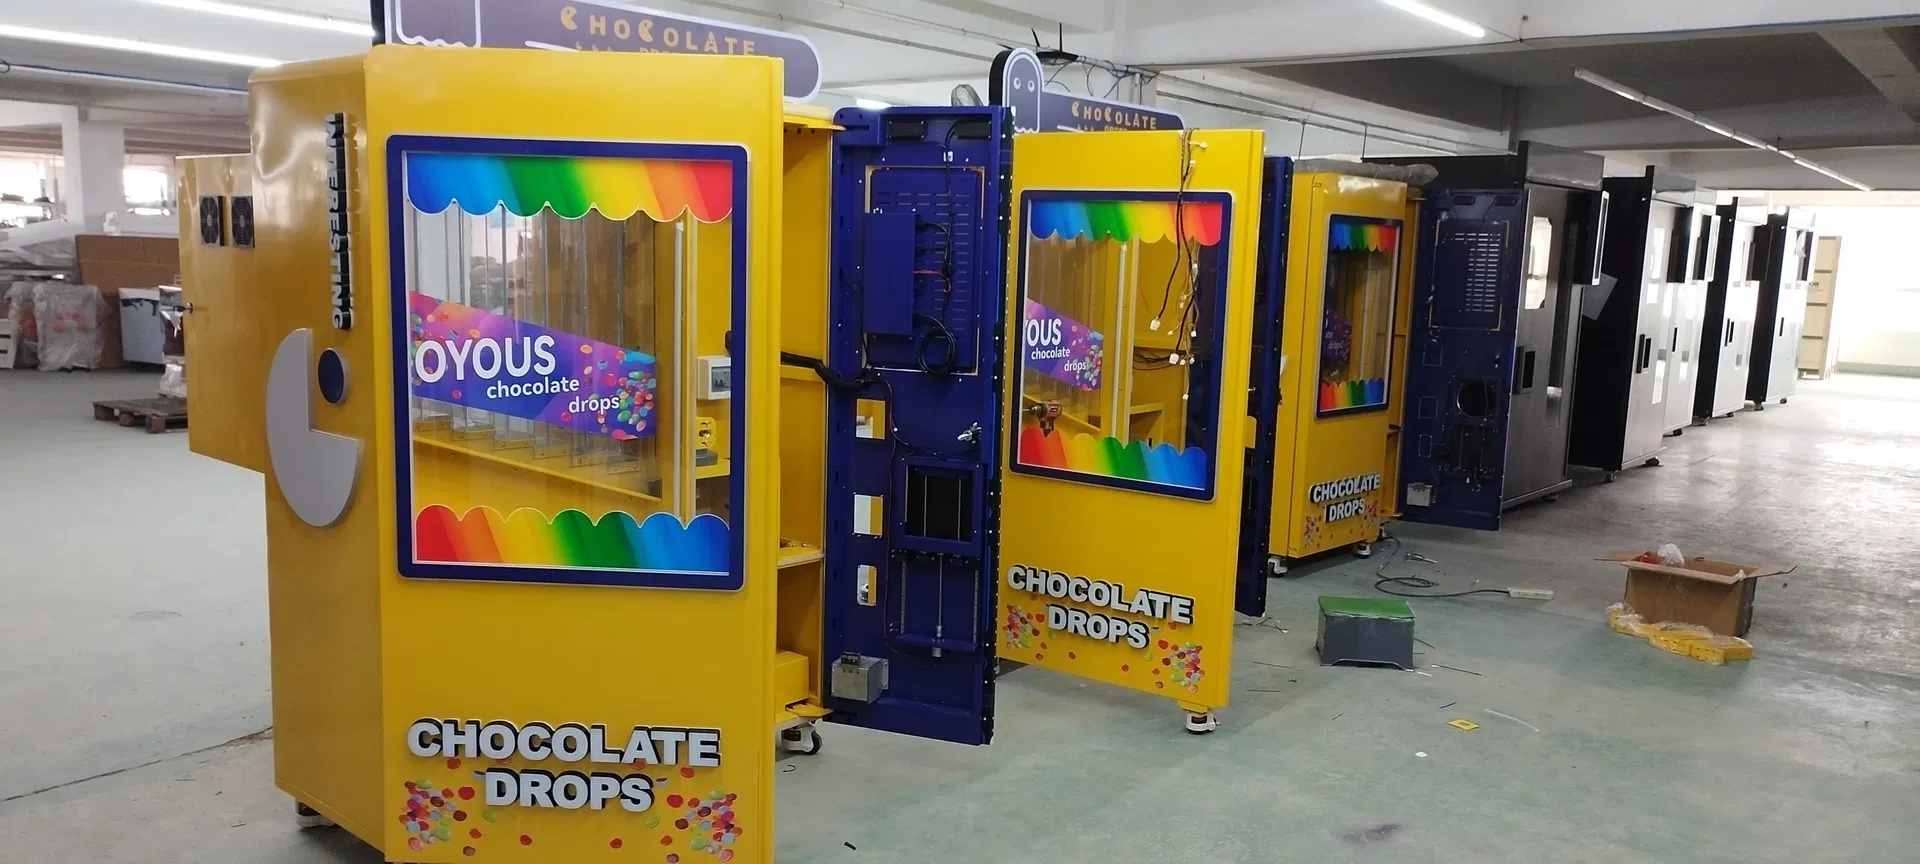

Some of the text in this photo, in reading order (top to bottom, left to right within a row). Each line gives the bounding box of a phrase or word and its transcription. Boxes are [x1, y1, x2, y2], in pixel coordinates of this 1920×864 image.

[561, 6, 755, 55] CHOCOLATE
[1071, 101, 1157, 130] CHOCOLATE
[324, 112, 351, 330] INTERESTING
[1031, 346, 1071, 360] chocolate
[1064, 360, 1087, 374] drops
[486, 376, 580, 399] chocolate
[568, 396, 620, 416] drops
[1309, 473, 1380, 503] CHOCOLATE
[1324, 497, 1366, 522] DROPS
[1007, 564, 1194, 624] CHOCOLATE
[1047, 603, 1150, 649] DROPS
[407, 717, 721, 767] CHOCOLATE
[484, 767, 655, 813] DROPS
